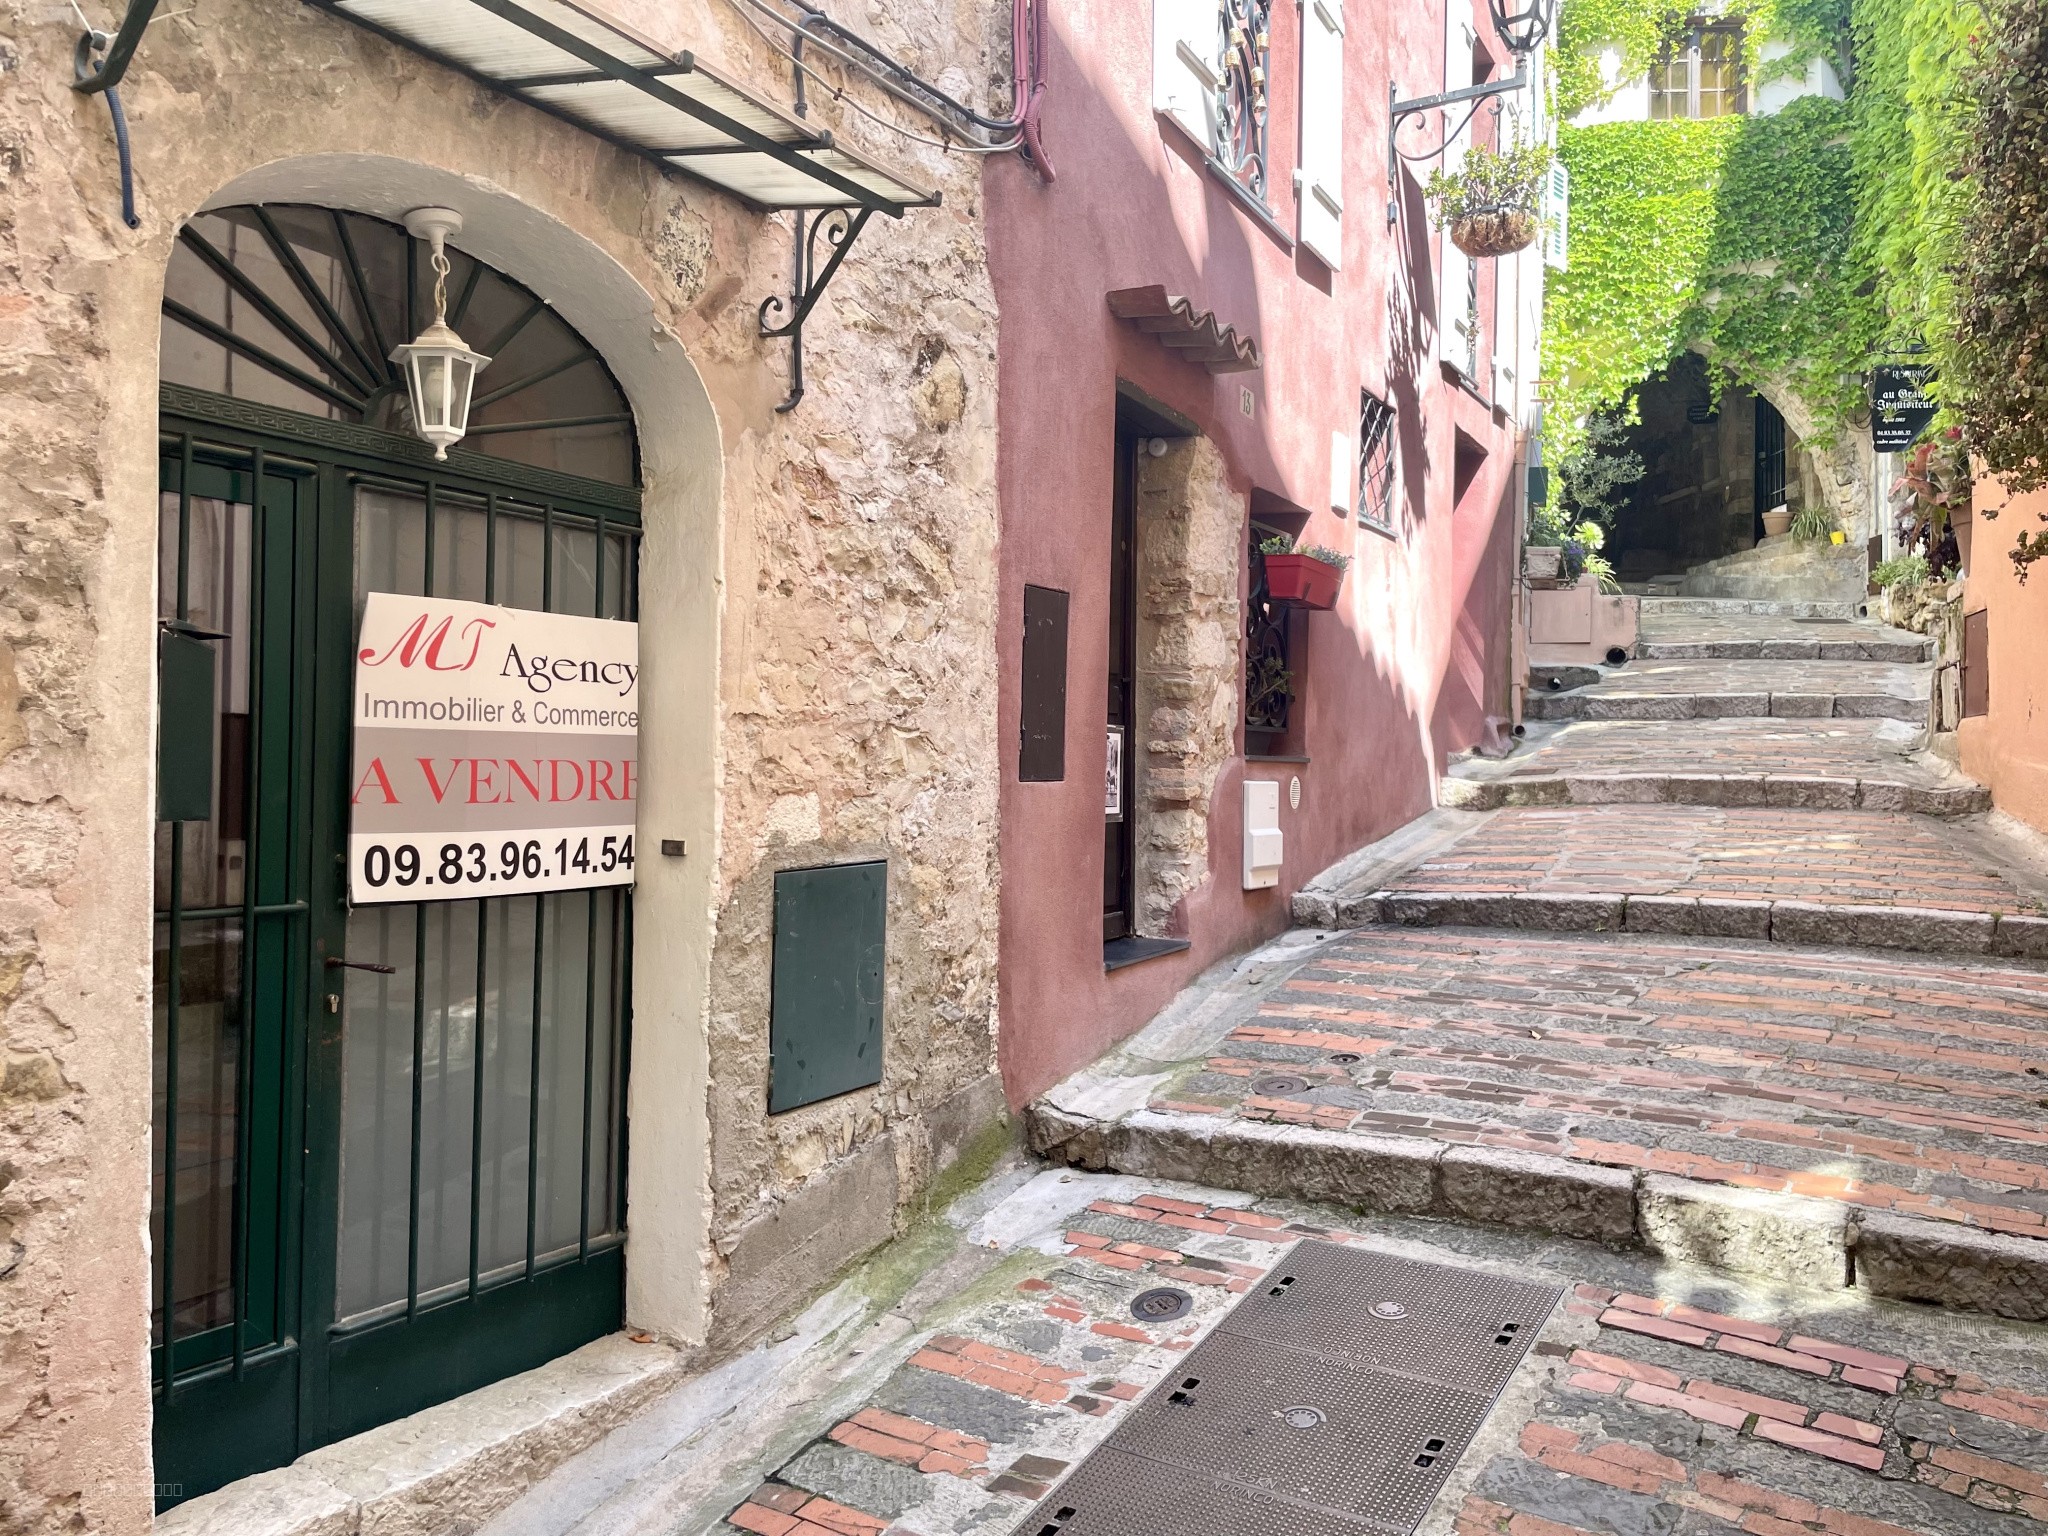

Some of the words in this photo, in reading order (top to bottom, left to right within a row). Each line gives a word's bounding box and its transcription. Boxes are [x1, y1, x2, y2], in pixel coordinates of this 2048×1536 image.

[1242, 390, 1251, 415] 13
[1882, 391, 1895, 399] au
[1898, 388, 1928, 399] Gran
[359, 613, 496, 672] MT
[500, 643, 639, 697] Agency
[364, 692, 505, 722] Immobilier
[512, 699, 527, 724] &
[534, 701, 638, 728] Commerce
[351, 757, 402, 804] A
[364, 834, 635, 887] 09.83.96.14.54
[1316, 1356, 1374, 1375] NORINCO
[1323, 1346, 1381, 1365] NORINCO
[1210, 1480, 1274, 1504] NORINCO
